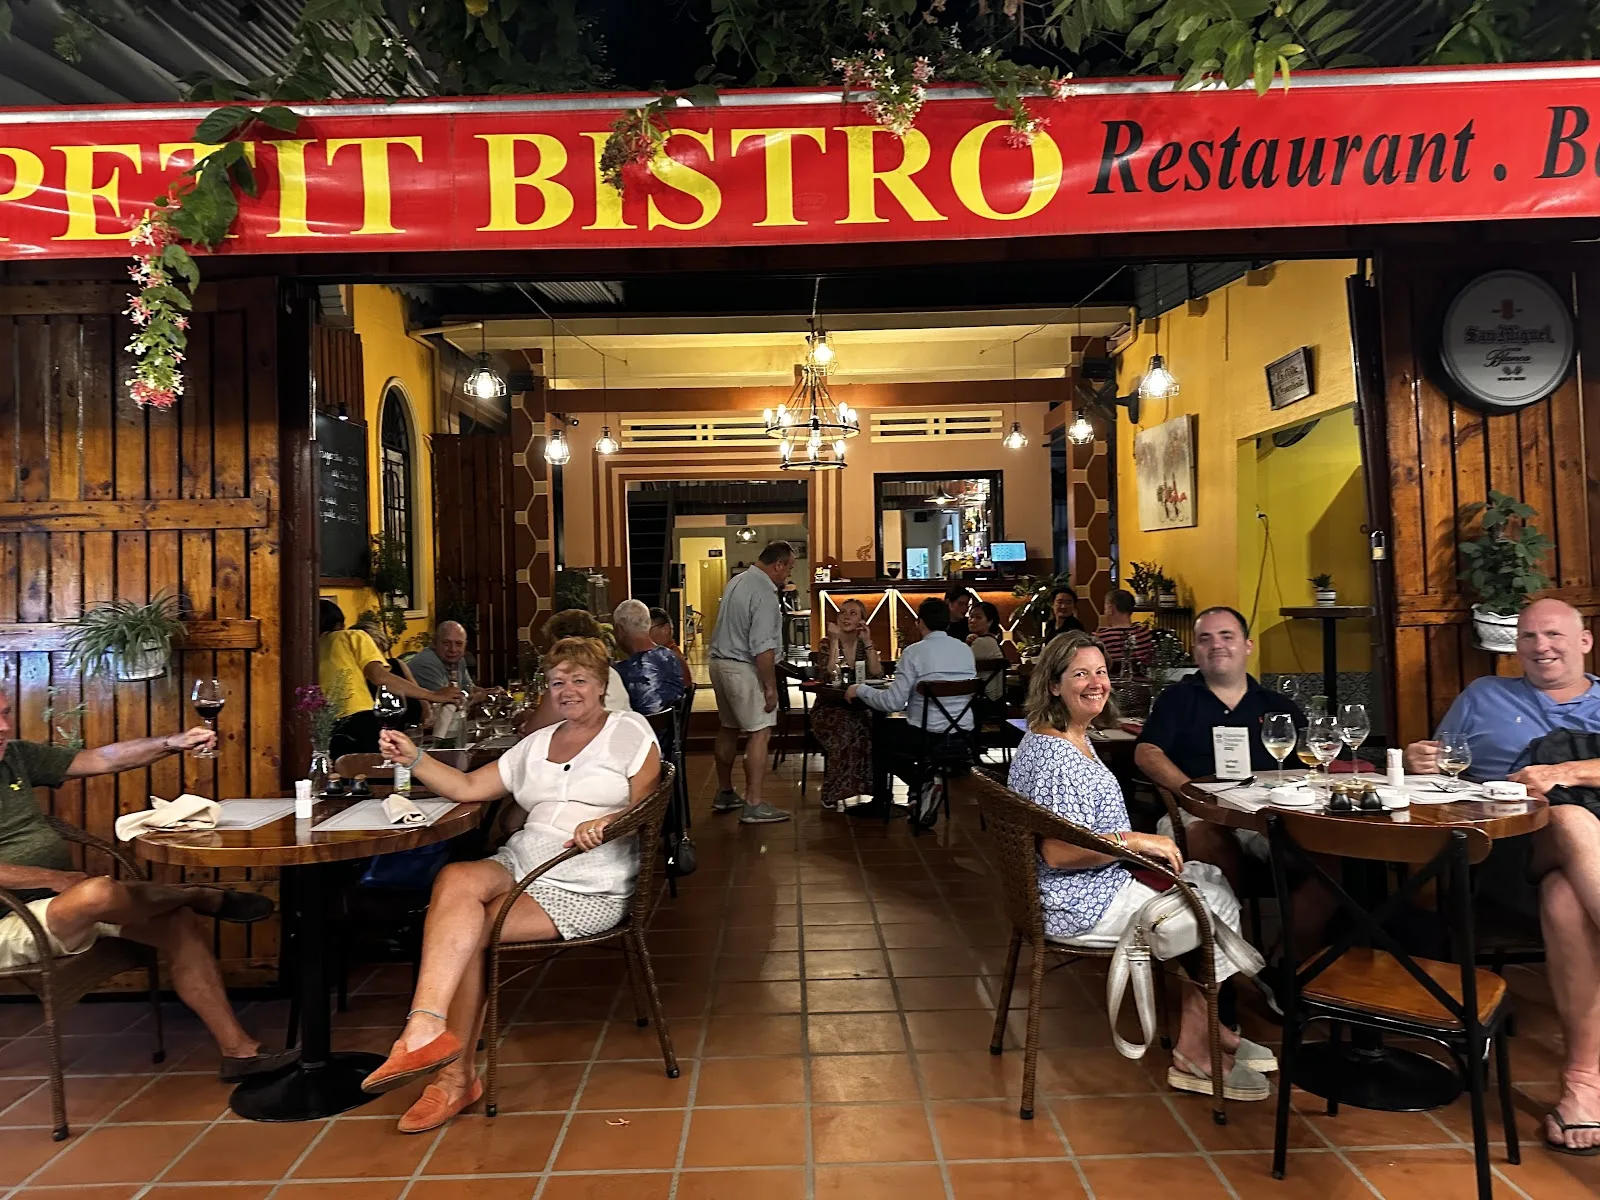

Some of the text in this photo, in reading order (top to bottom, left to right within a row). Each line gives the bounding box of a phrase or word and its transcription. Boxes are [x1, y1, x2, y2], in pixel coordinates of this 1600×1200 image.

[475, 124, 1064, 232] BISTRO
[1087, 119, 1476, 194] Restaurant
[1534, 105, 1600, 179] B
